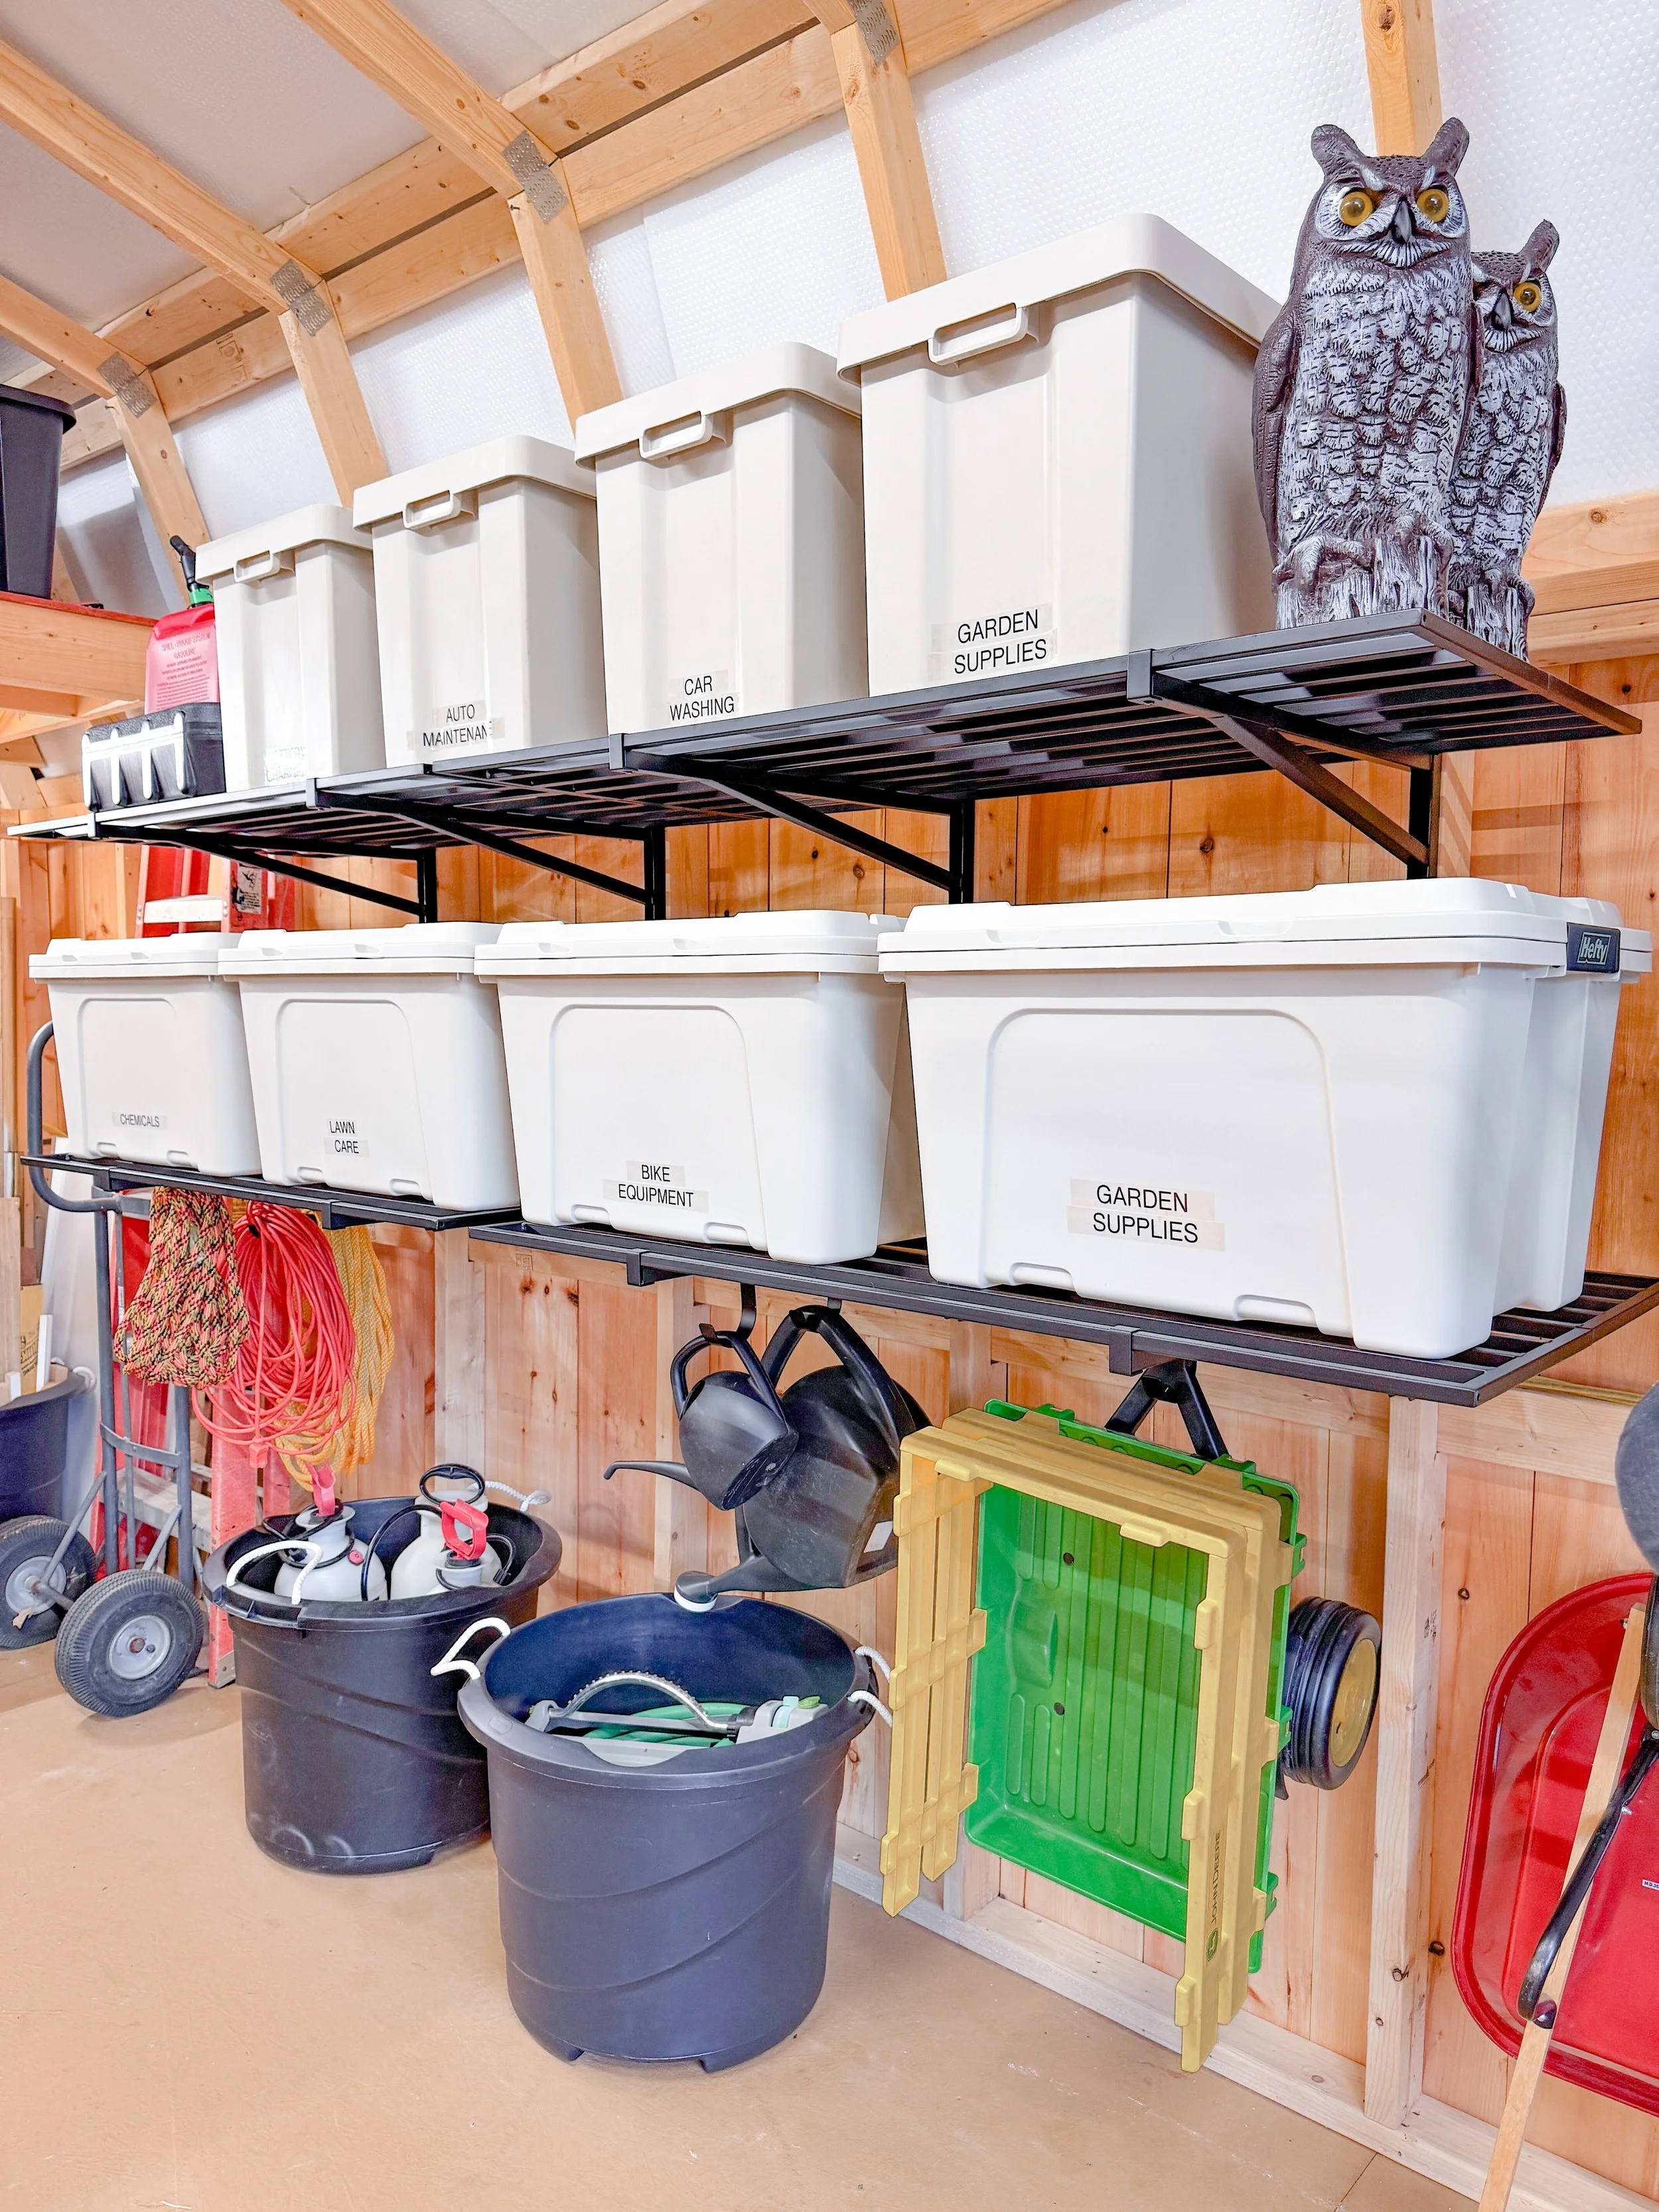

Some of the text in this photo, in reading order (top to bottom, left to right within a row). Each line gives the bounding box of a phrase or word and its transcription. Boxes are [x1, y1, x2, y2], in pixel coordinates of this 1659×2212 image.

[958, 609, 1039, 644] GARDEN
[954, 638, 1047, 674] SUPPLIES
[684, 675, 713, 696] CAR
[446, 703, 475, 723] AUTO
[670, 696, 735, 721] WASHING
[423, 721, 492, 747] MAINTENAN
[1580, 936, 1607, 964] Hefty
[119, 1113, 160, 1128] CHEMICALS
[329, 1120, 355, 1134] LAWN
[334, 1140, 359, 1154] CARE
[641, 1164, 671, 1183] BIKE
[618, 1183, 694, 1207] EQUIPMENT
[1096, 1184, 1188, 1213] GARDEN
[1093, 1212, 1198, 1243] SUPPLIES
[1212, 1831, 1220, 1884] DEERE
